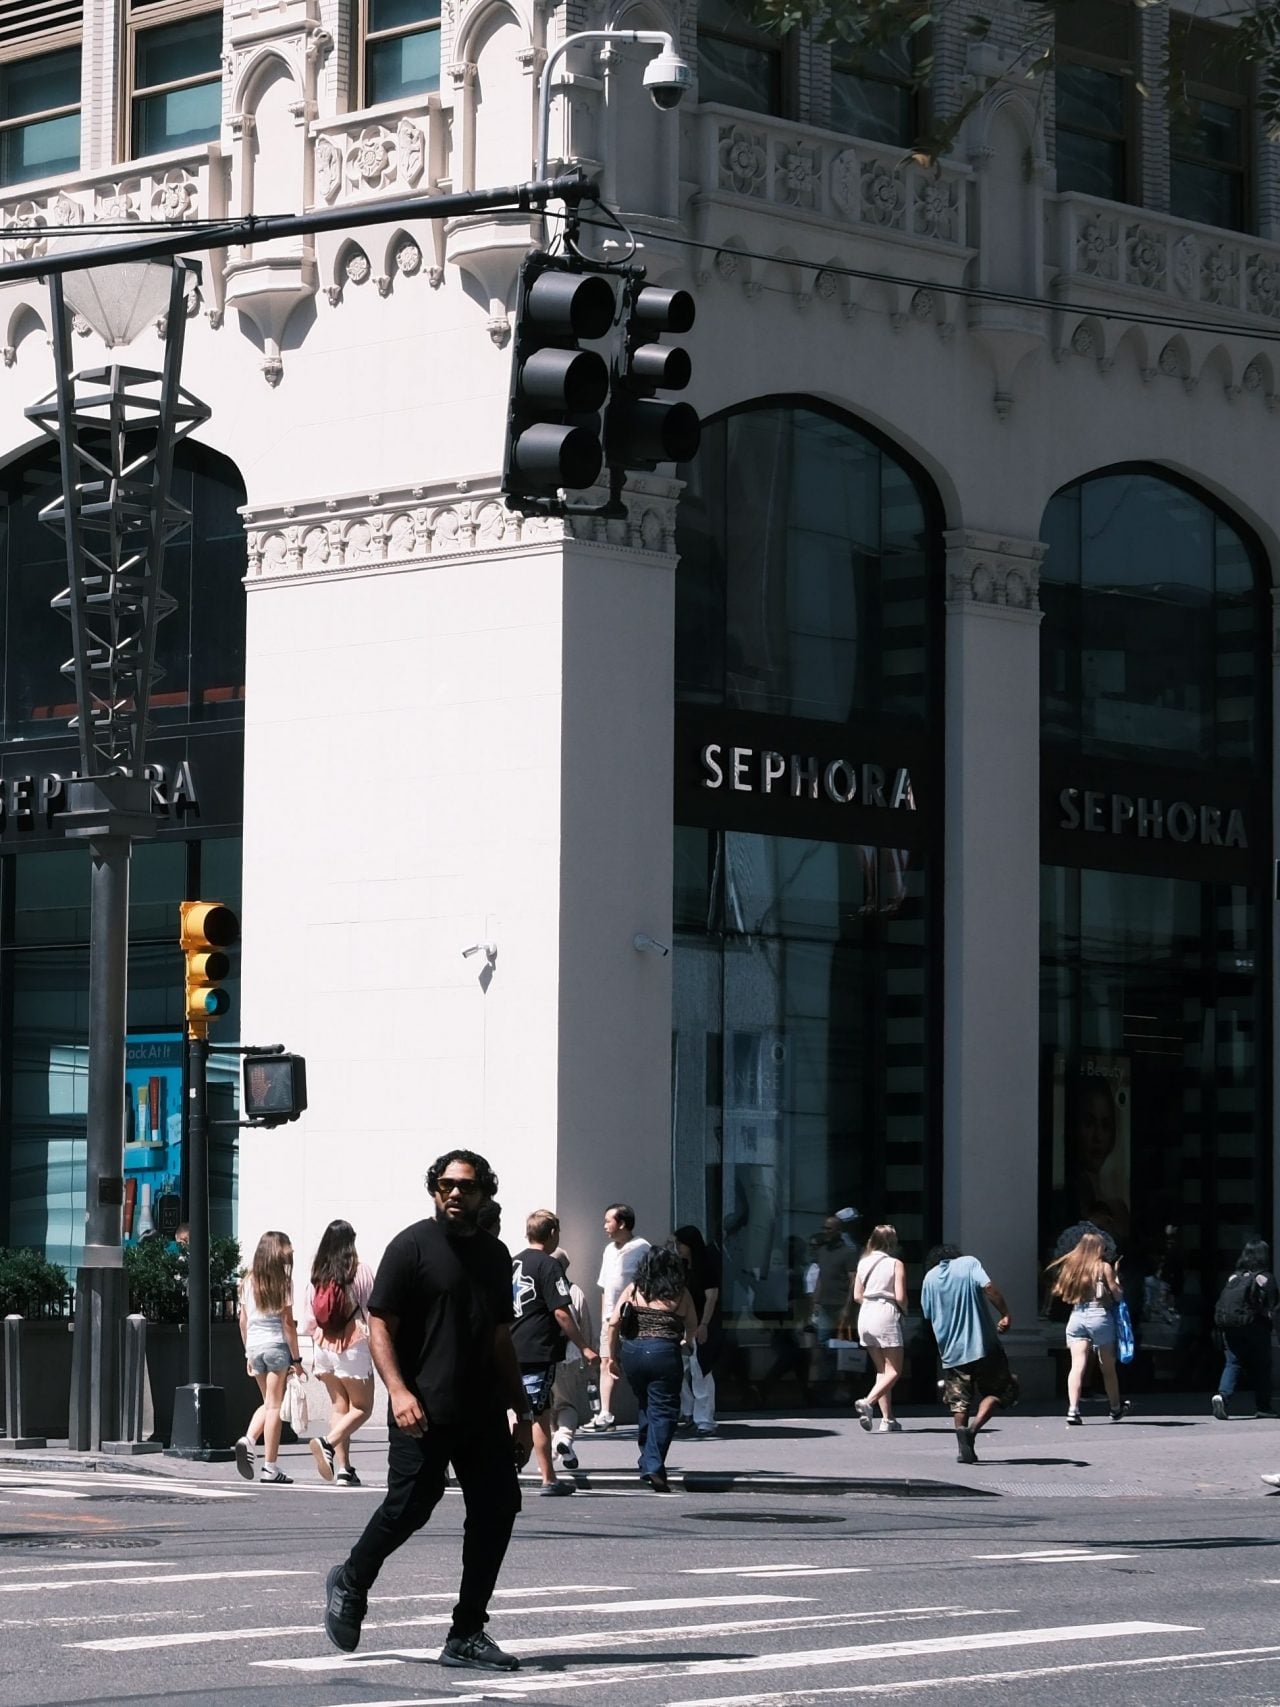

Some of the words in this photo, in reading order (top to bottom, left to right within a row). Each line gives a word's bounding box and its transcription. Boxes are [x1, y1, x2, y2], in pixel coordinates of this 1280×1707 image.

[701, 743, 917, 811] SEPHORA
[1058, 787, 1249, 848] SEPHORA
[128, 1044, 147, 1059] ack
[148, 1044, 161, 1058] At
